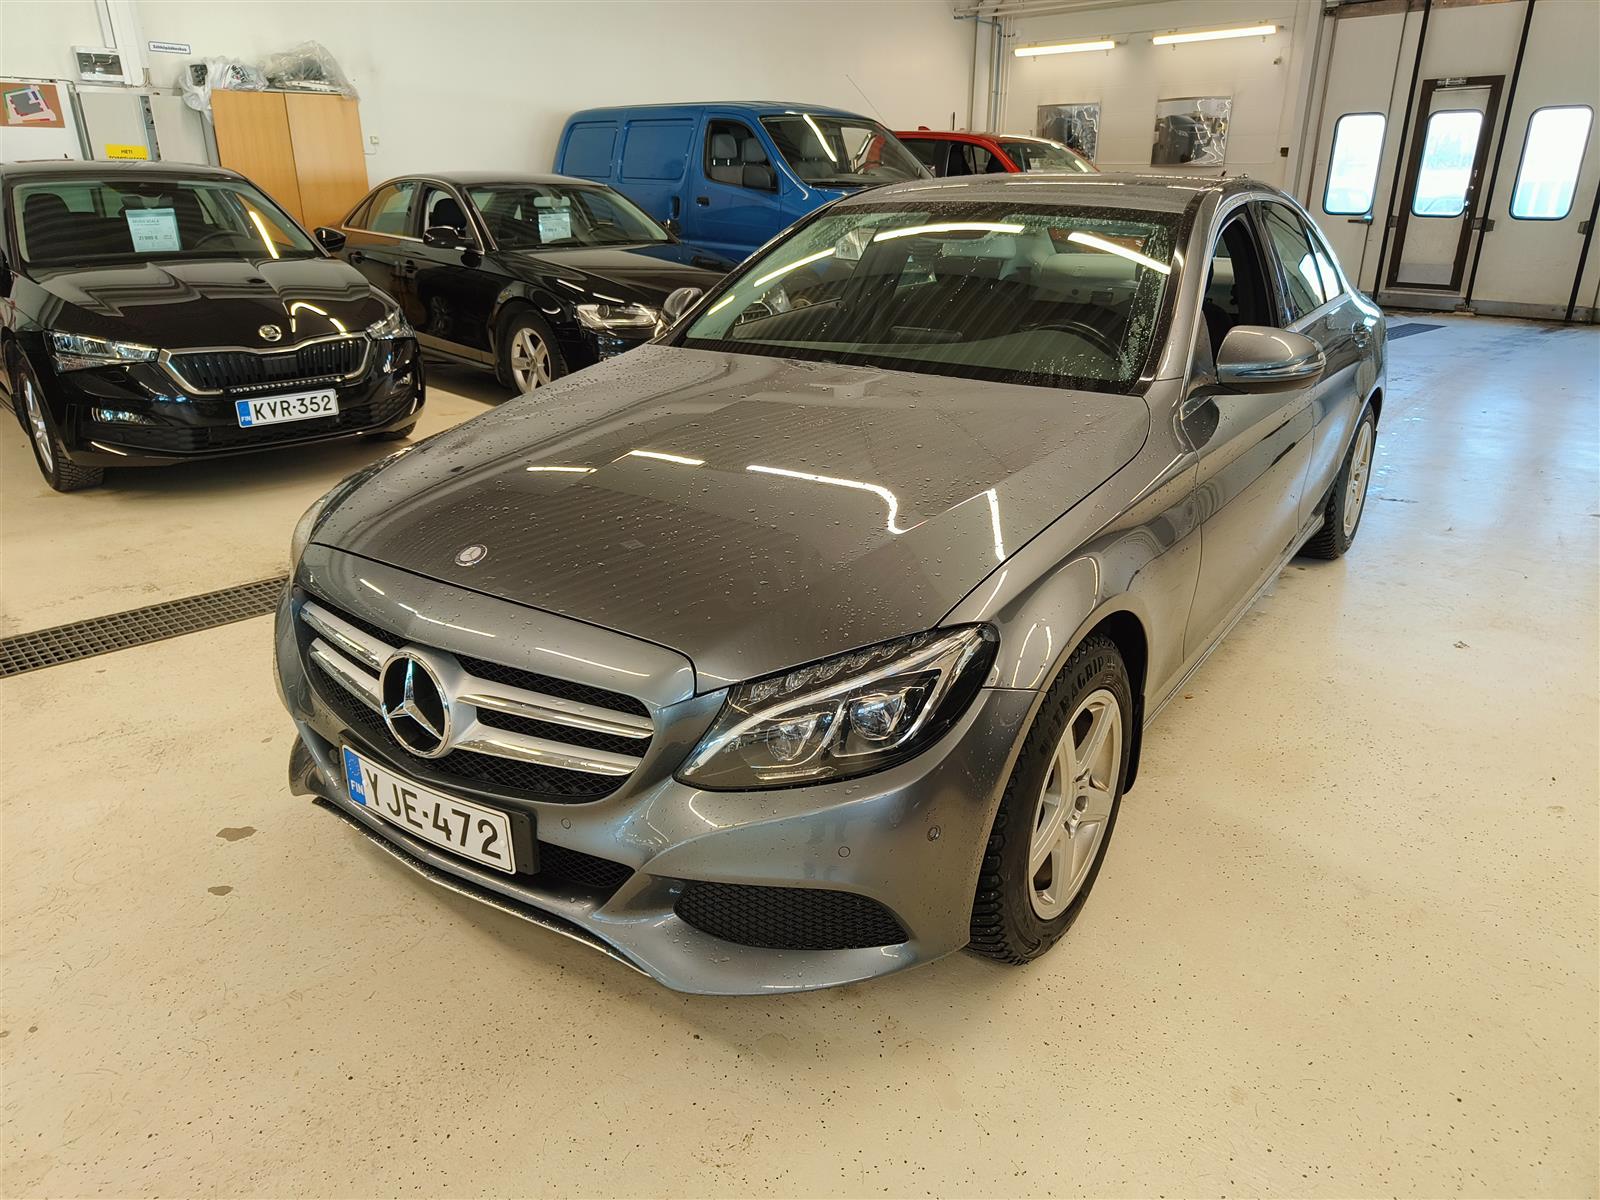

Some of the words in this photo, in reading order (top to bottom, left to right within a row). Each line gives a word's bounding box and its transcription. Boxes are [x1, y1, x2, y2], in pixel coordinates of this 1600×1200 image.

[253, 394, 332, 420] KVR-352
[351, 780, 365, 796] FIN
[365, 768, 501, 860] YJE-472
